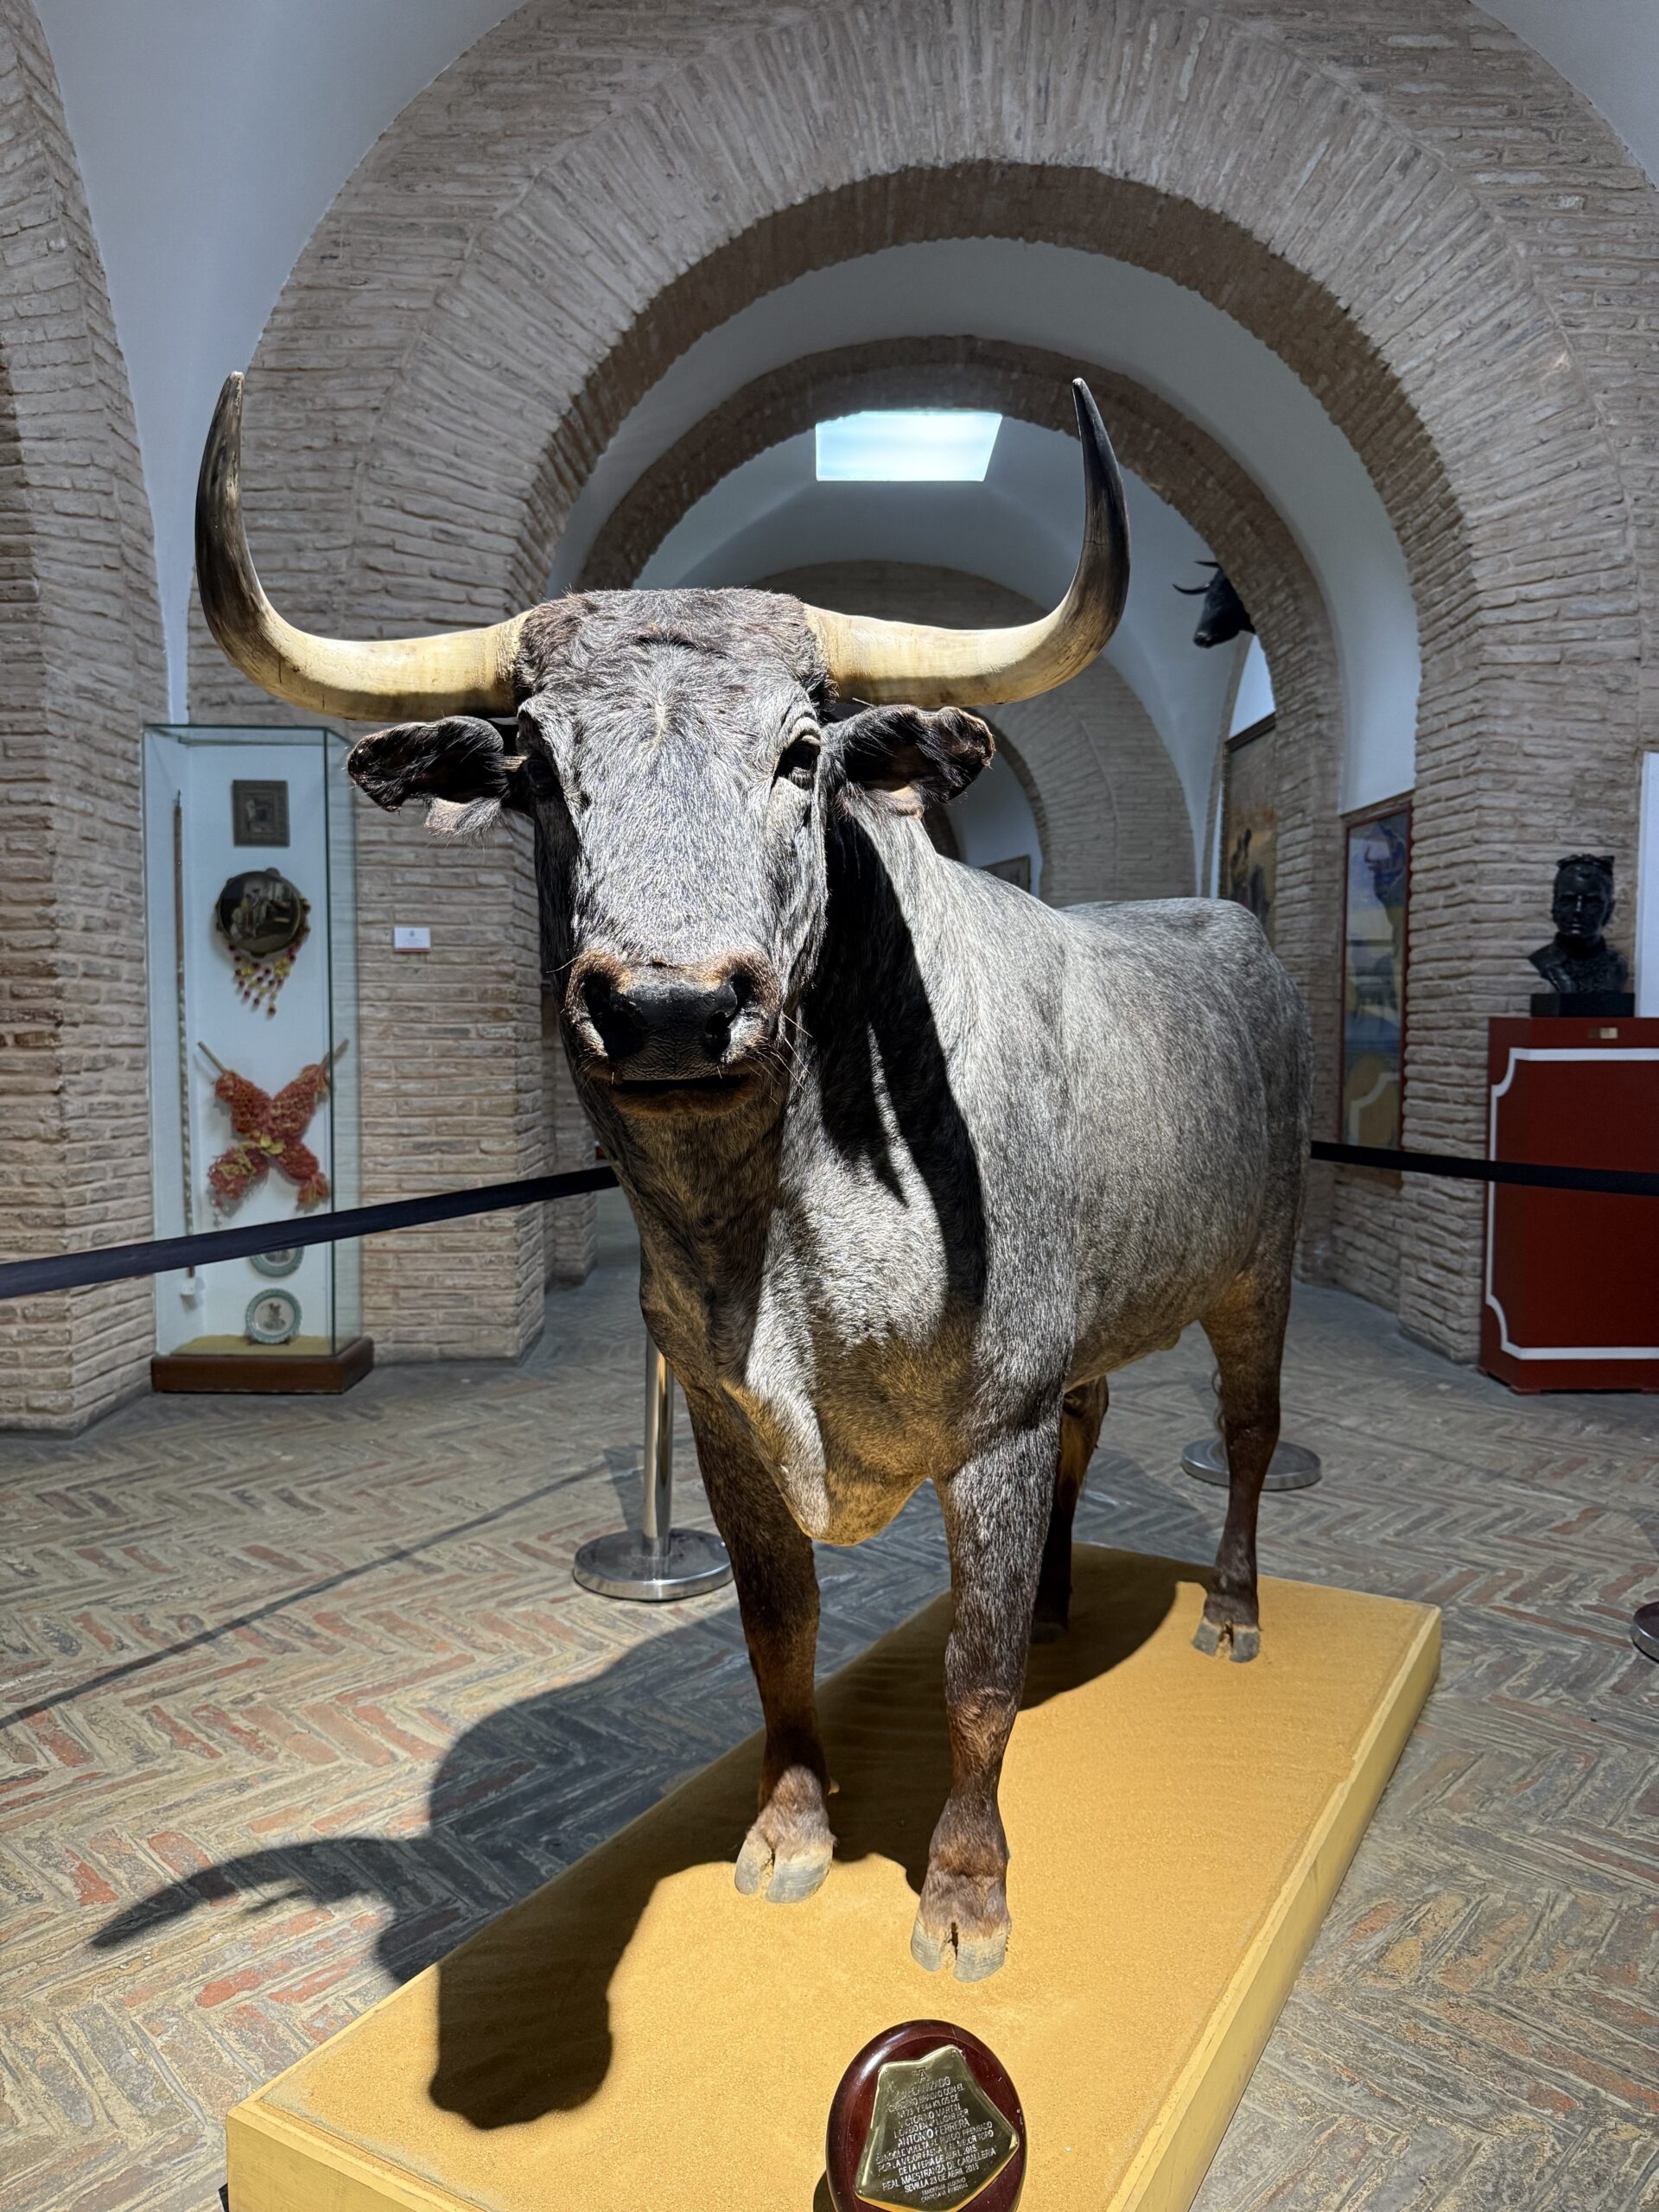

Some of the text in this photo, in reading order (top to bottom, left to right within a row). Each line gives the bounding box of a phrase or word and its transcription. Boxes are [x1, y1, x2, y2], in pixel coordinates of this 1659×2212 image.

[932, 2096, 950, 2107] KILOS
[950, 2094, 960, 2102] DE
[943, 2086, 957, 2095] CON
[957, 2082, 965, 2091] EL
[896, 2117, 969, 2148] ANTONIO FERRERA
[918, 2121, 928, 2130] EN
[936, 2113, 956, 2125] LUGAR
[956, 2108, 969, 2119] POR
[878, 2162, 893, 2172] POR
[892, 2159, 901, 2168] LA
[900, 2152, 922, 2165] MEJOR
[922, 2145, 942, 2158] FAENA
[957, 2135, 977, 2147] MEJOR
[977, 2129, 995, 2141] TORO
[906, 2141, 930, 2154] VUELTA
[963, 2120, 993, 2137] PREMIADO
[881, 2178, 900, 2191] REAL
[900, 2164, 946, 2184] MAESTRANZA
[946, 2160, 957, 2170] DE
[957, 2147, 996, 2166] CABALLERIA
[898, 2166, 908, 2176] DE
[908, 2163, 918, 2172] LA
[917, 2158, 935, 2170] FERIA
[935, 2155, 945, 2164] DE
[944, 2149, 963, 2160] ABRIL
[904, 2178, 930, 2193] SEVILLA
[938, 2173, 947, 2182] DE
[947, 2167, 964, 2178] ABRIL
[965, 2163, 980, 2172] 2015
